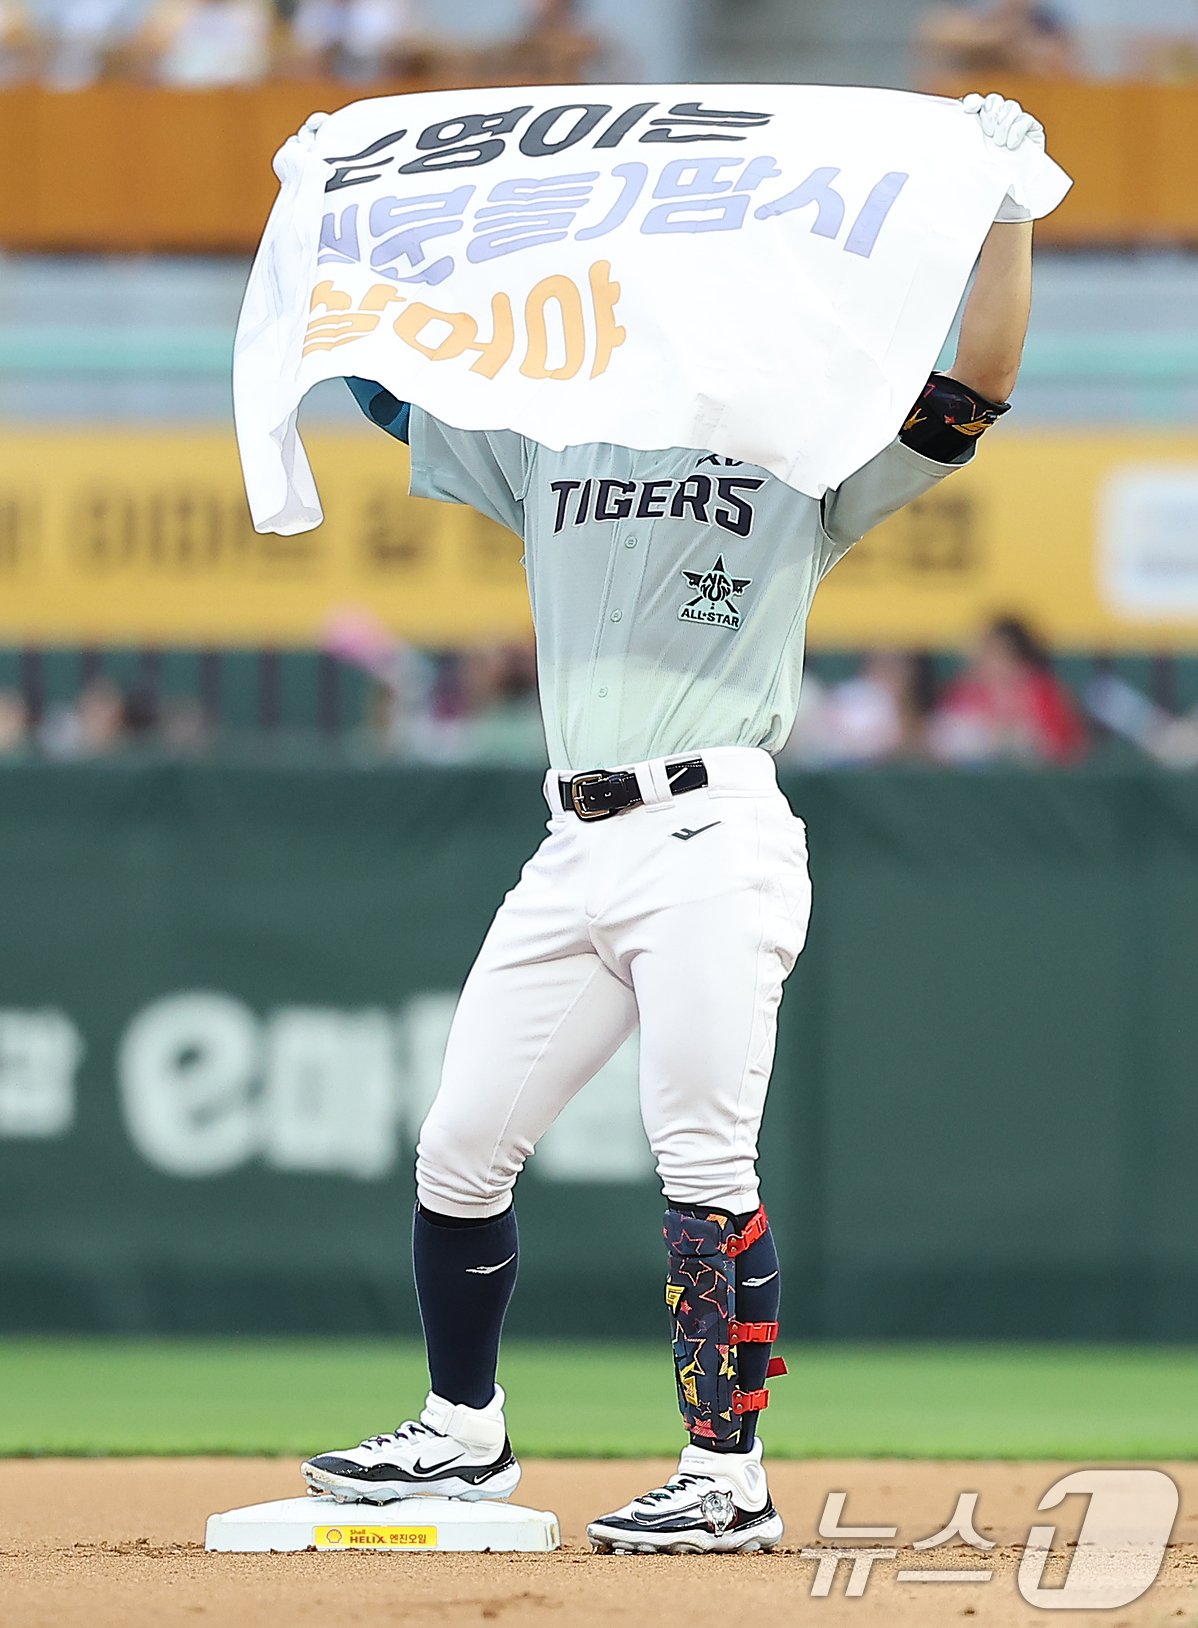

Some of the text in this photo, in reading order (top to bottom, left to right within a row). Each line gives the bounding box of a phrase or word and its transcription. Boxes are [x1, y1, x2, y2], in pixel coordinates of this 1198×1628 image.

[550, 474, 769, 538] TIGERS
[350, 1533, 427, 1545] HELIX 엔진오일
